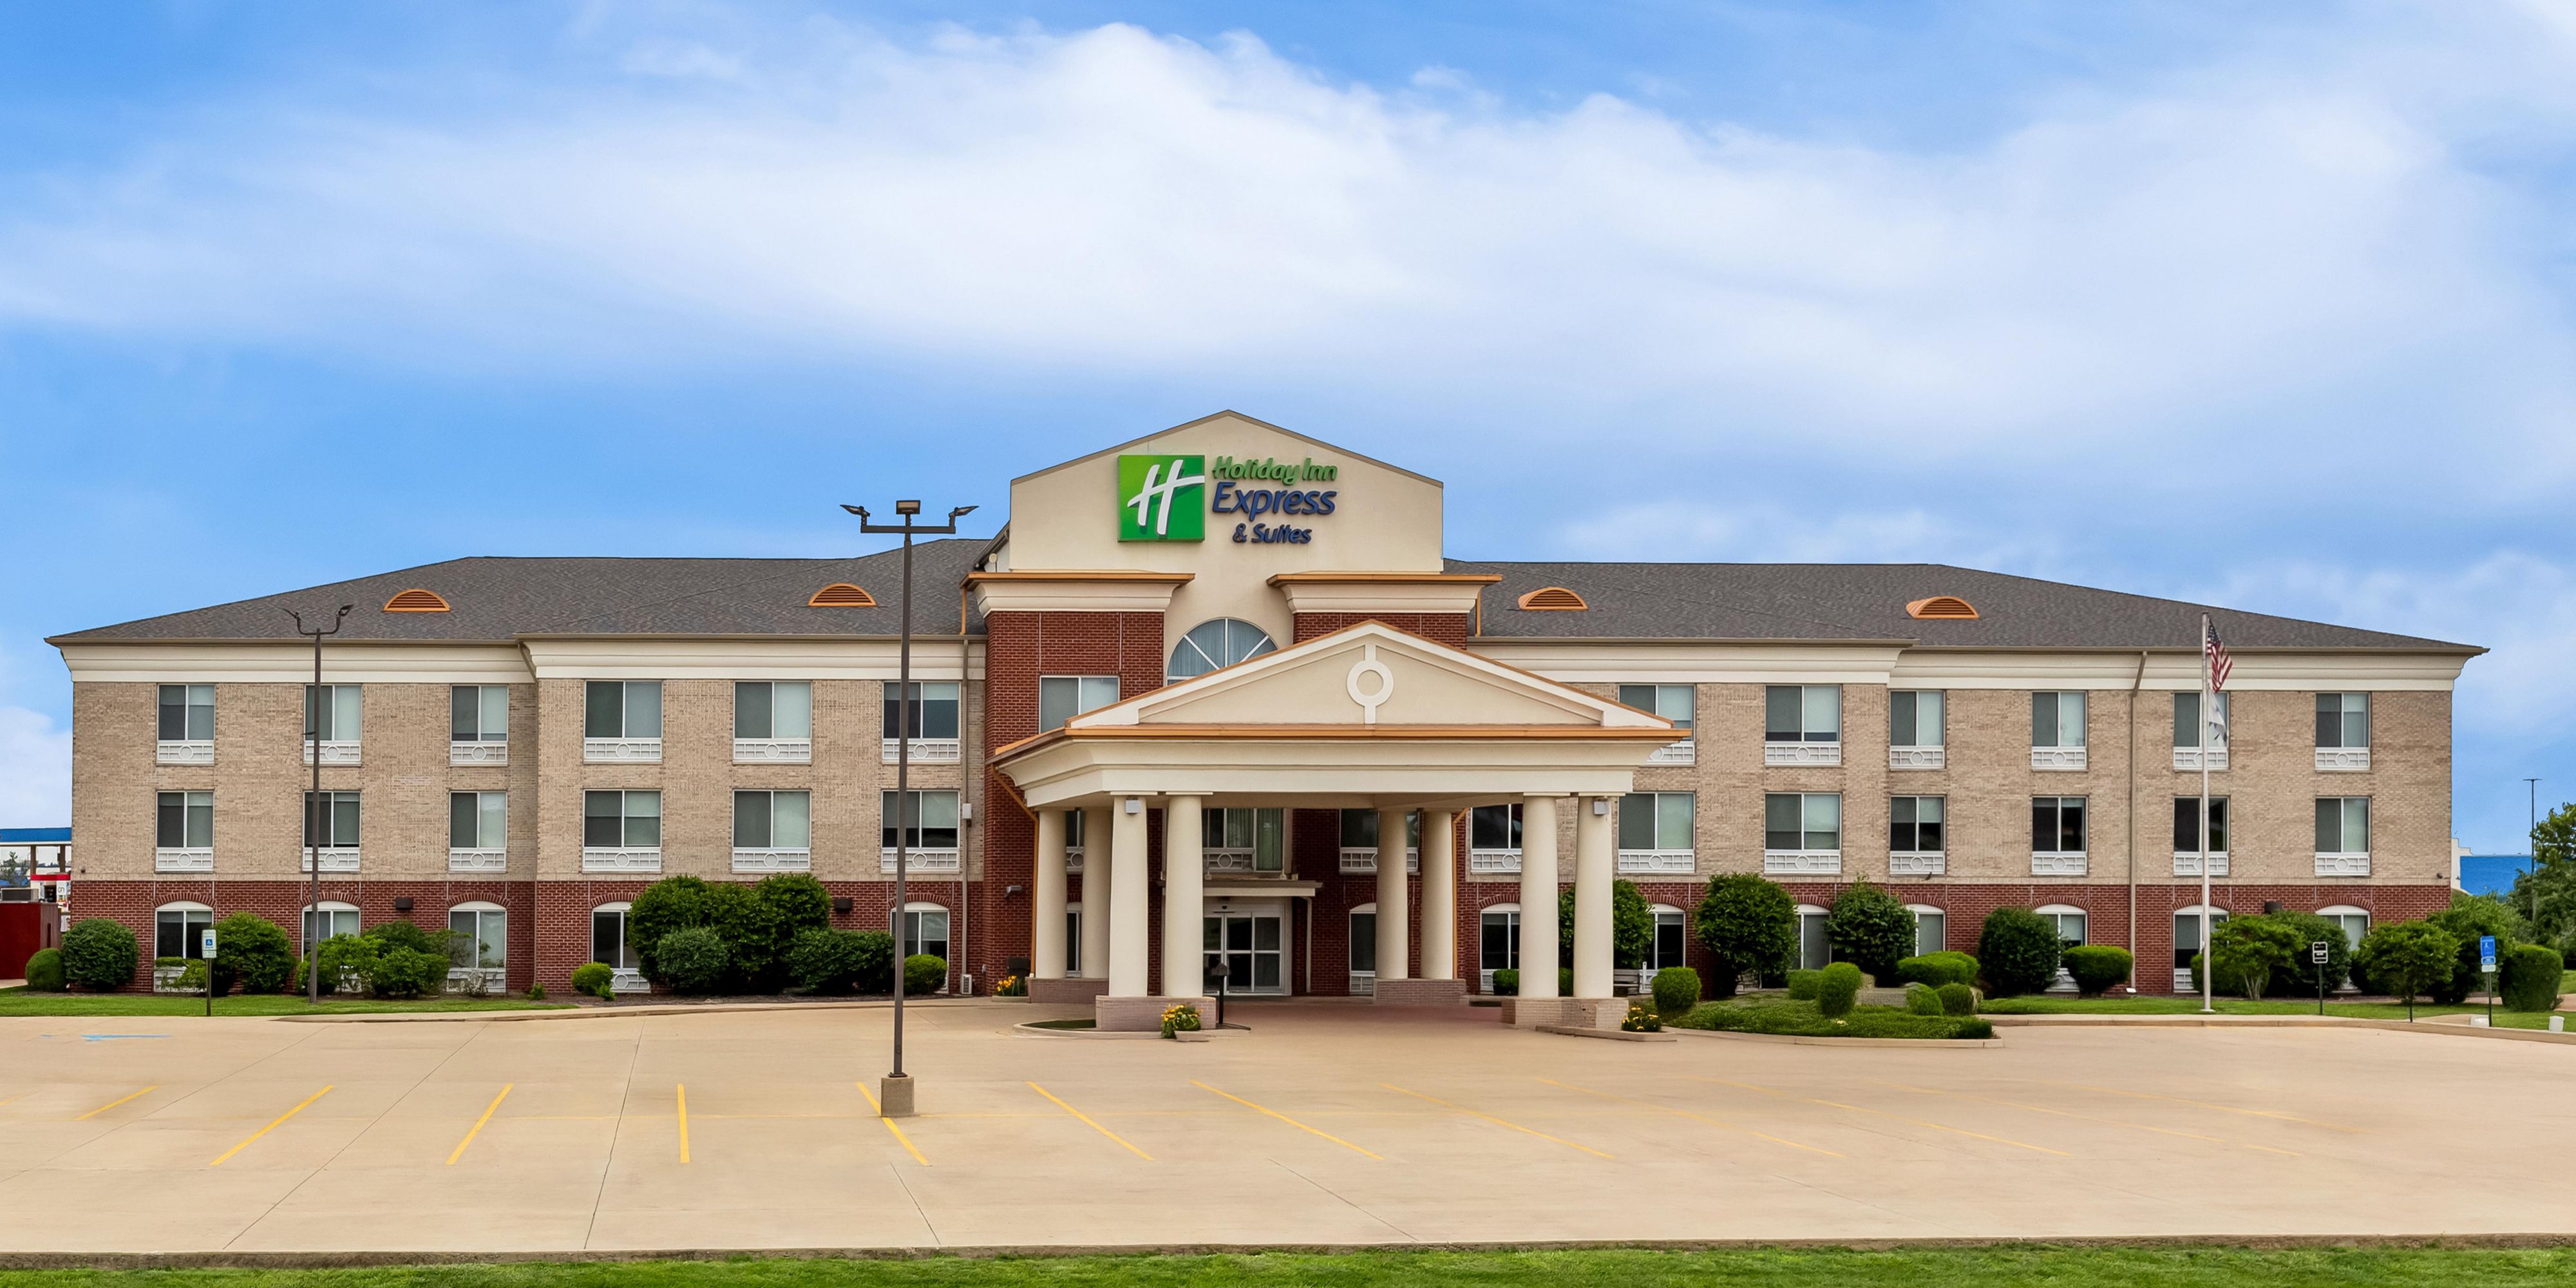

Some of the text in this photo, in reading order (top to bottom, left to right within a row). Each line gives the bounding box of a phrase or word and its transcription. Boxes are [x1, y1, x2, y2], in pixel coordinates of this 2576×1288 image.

[1212, 456, 1338, 485] Holiday Inn
[1127, 459, 1205, 536] H
[1212, 482, 1337, 522] Express
[1232, 523, 1312, 544] & Suites
